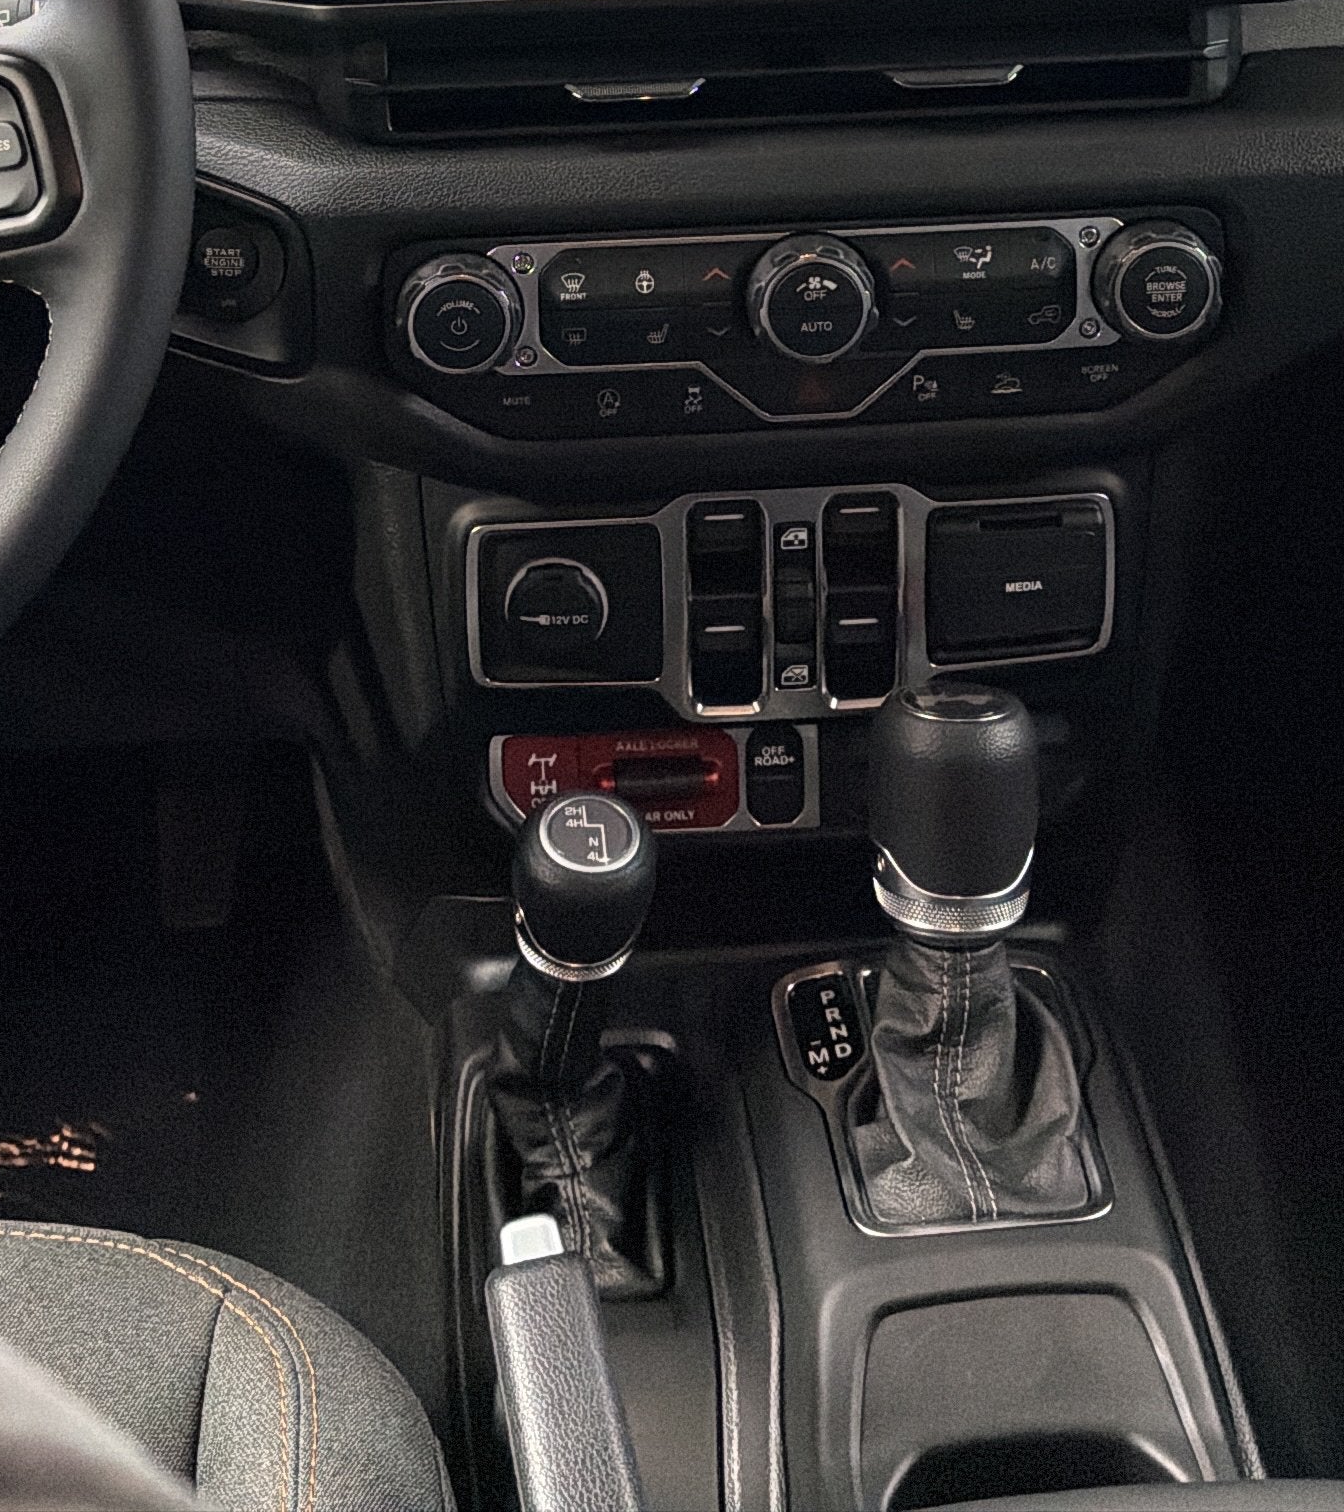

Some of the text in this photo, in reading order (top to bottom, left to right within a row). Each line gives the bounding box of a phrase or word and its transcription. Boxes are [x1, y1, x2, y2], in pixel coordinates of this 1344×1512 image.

[204, 258, 245, 266] ENGINE
[1030, 256, 1056, 270] A/C
[1156, 266, 1177, 274] TUNE
[962, 272, 986, 280] MODE
[1146, 282, 1186, 291] BROWSE
[560, 293, 586, 302] FRONT
[804, 290, 827, 301] OFF
[1152, 294, 1182, 302] ENTER
[440, 300, 474, 312] VOLUME
[801, 321, 833, 332] AUTO
[1082, 364, 1118, 374] SCREEN
[1090, 374, 1108, 382] OFF
[503, 396, 531, 406] MUTE
[918, 393, 937, 401] OFF
[600, 408, 618, 418] OFF
[684, 405, 702, 414] OFF
[1006, 581, 1043, 592] MEDIA
[551, 615, 589, 625] 12V DC
[762, 746, 785, 756] OFF
[754, 755, 795, 766] ROAD+
[564, 806, 582, 816] 2H
[566, 818, 584, 827] 4H
[589, 837, 598, 846] N
[820, 990, 835, 1005] P
[825, 1007, 842, 1023] R
[830, 1024, 848, 1041] N
[835, 1043, 852, 1058] D
[808, 1047, 829, 1065] M
